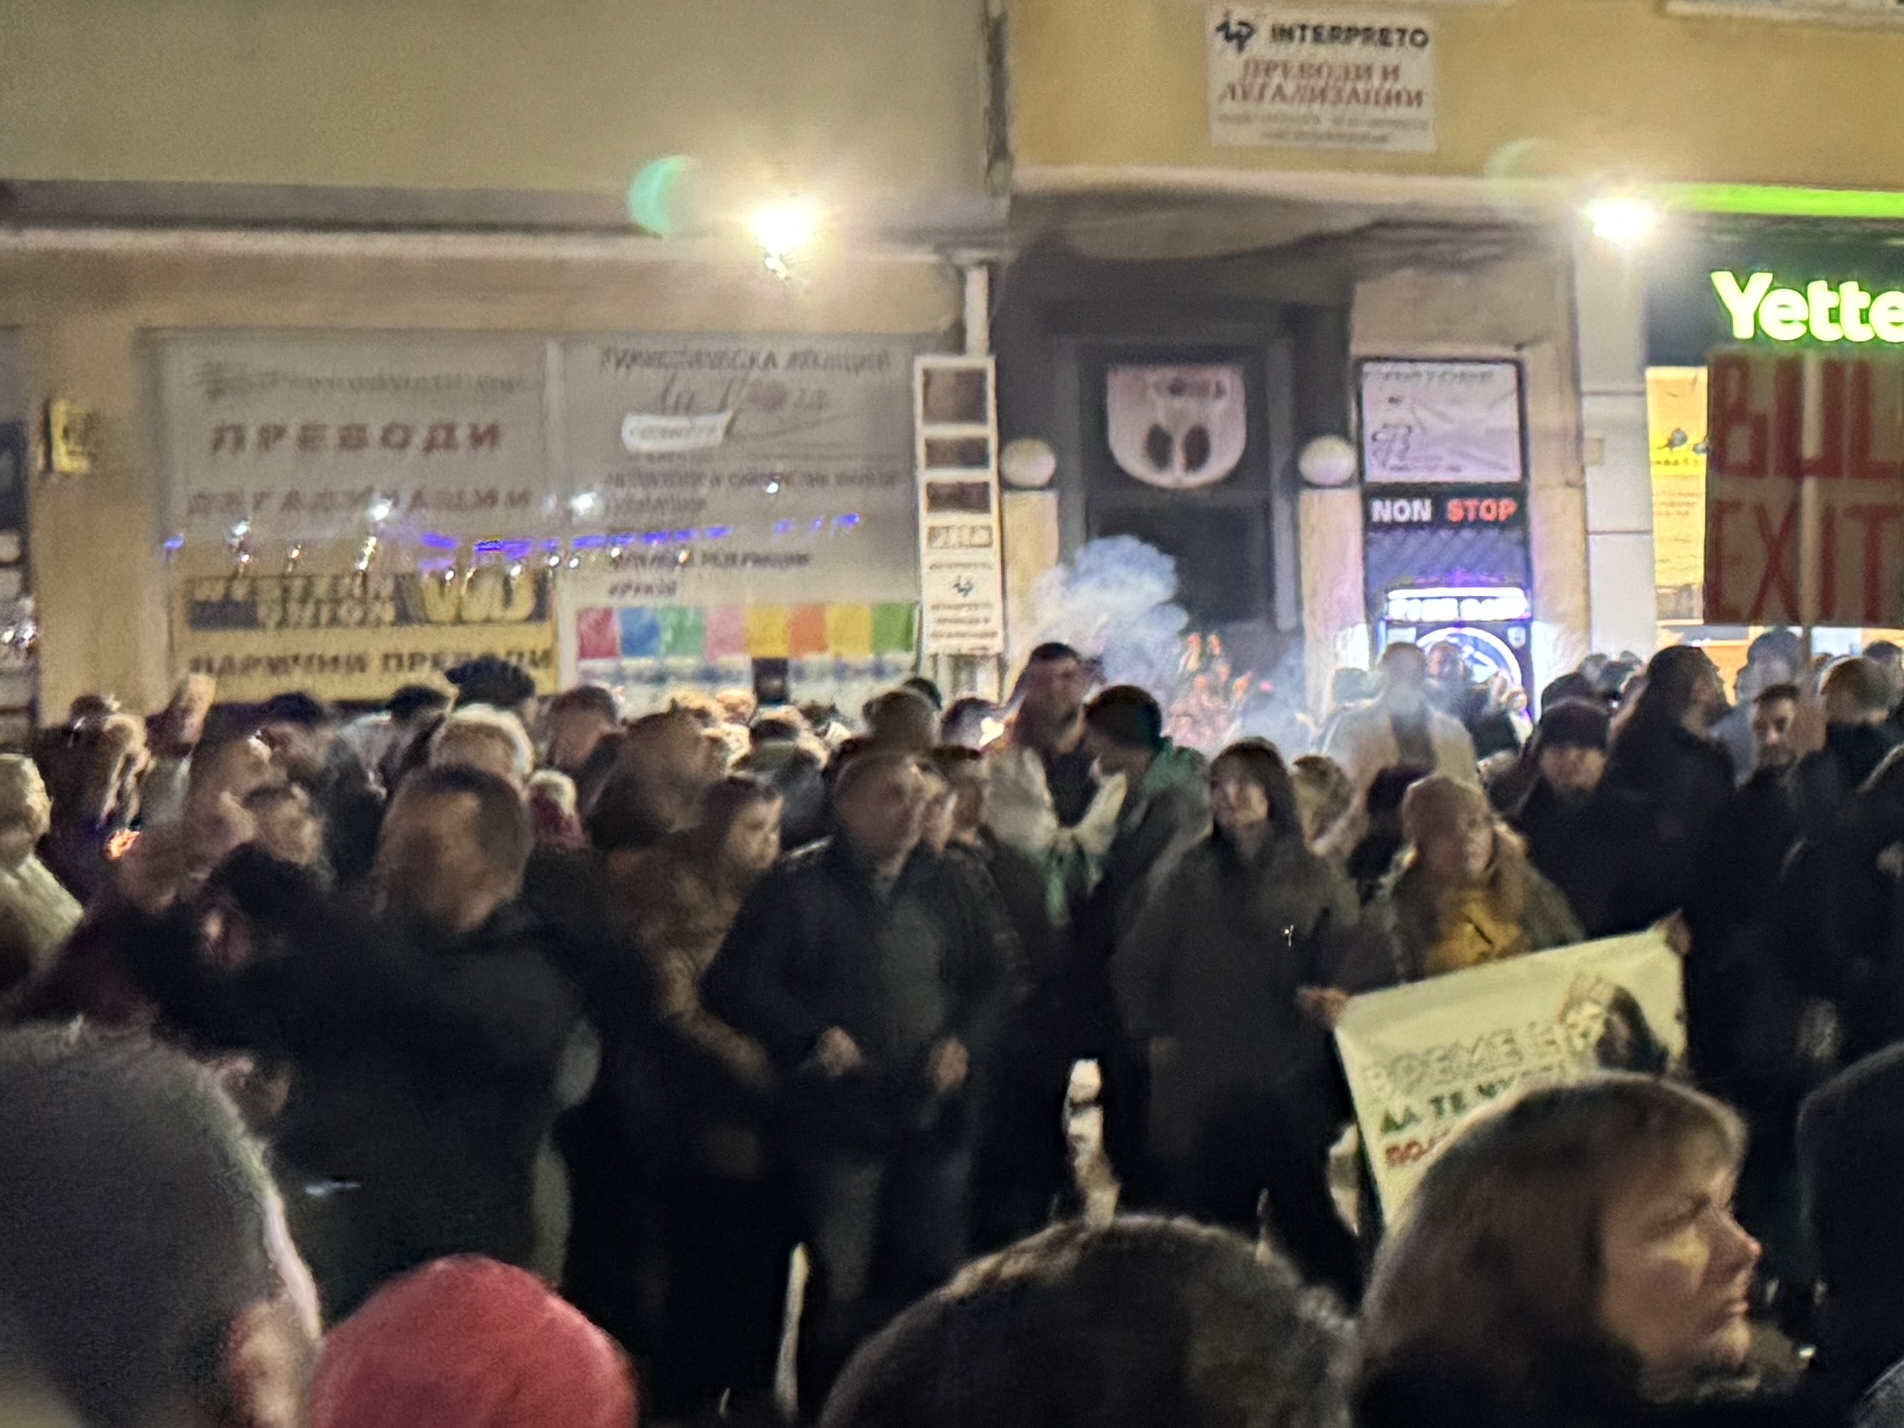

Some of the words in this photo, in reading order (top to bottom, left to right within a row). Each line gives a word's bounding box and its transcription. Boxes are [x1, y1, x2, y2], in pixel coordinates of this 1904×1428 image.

[1269, 22, 1429, 49] INTERPRETO
[211, 421, 501, 456] ПРЕВОДИ
[1371, 498, 1433, 523] NON
[1446, 498, 1518, 523] STOP
[1706, 499, 1901, 625] EXIT
